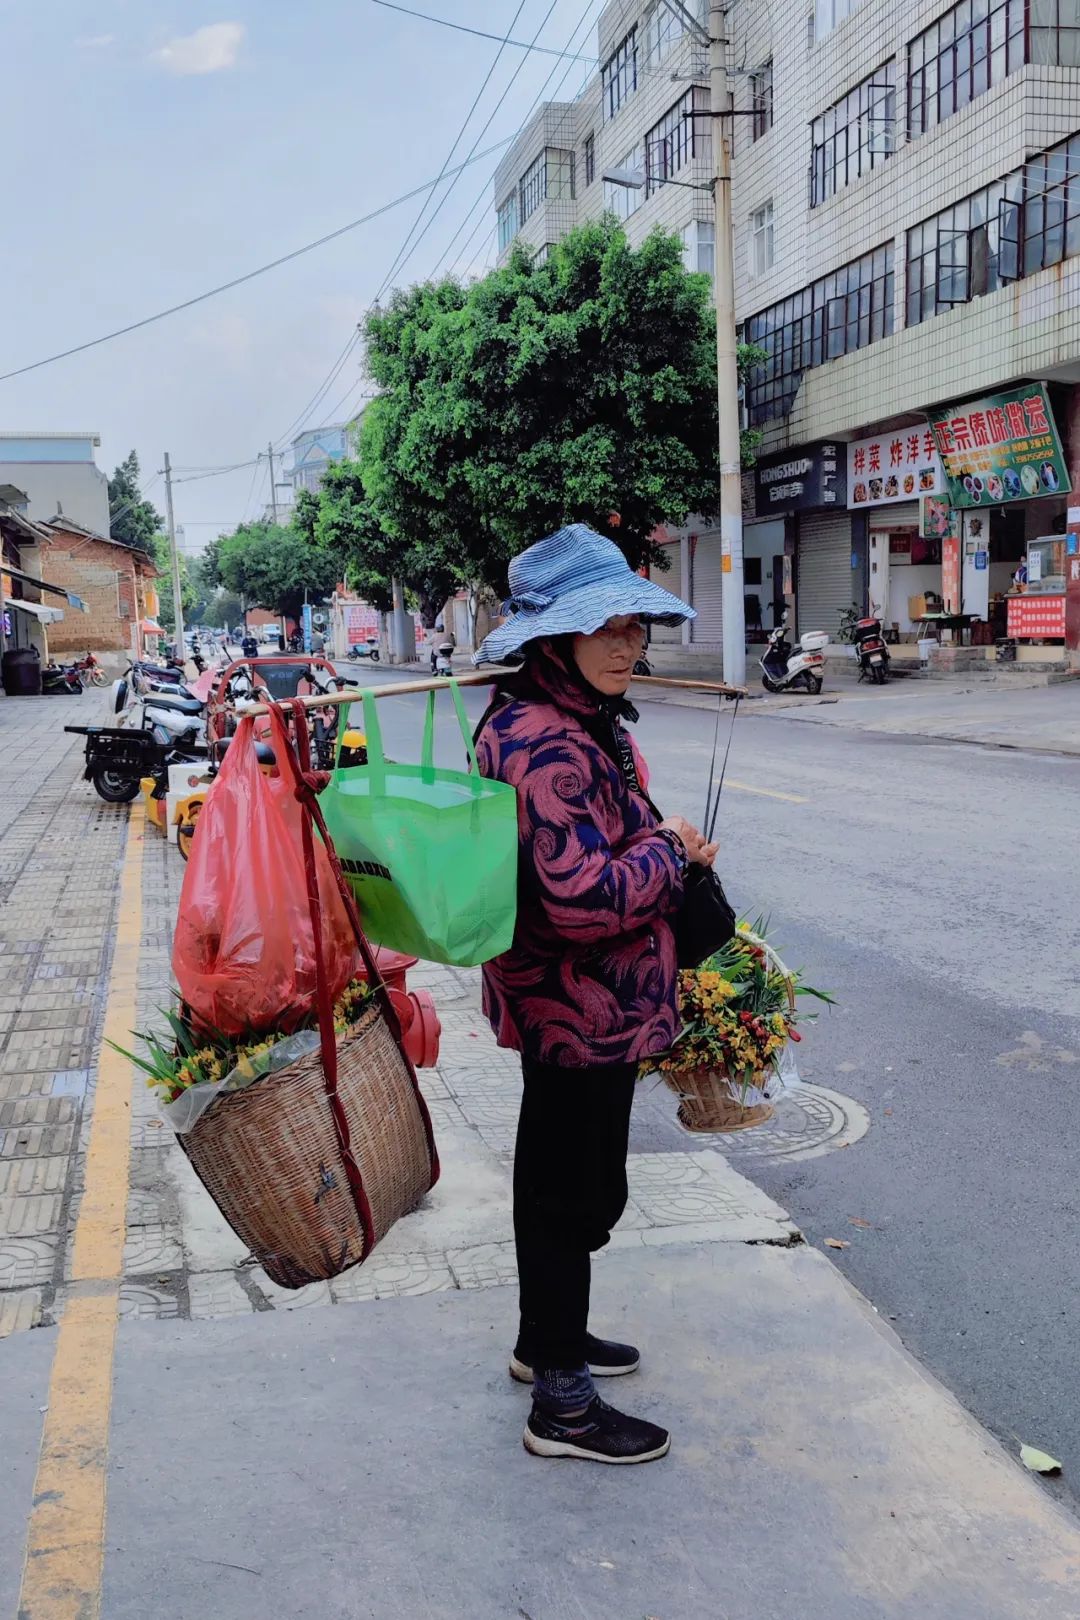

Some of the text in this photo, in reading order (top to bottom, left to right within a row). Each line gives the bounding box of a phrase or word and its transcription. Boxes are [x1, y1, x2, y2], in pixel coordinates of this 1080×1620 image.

[854, 443, 881, 476] 拌菜
[890, 429, 937, 468] 炸洋芋
